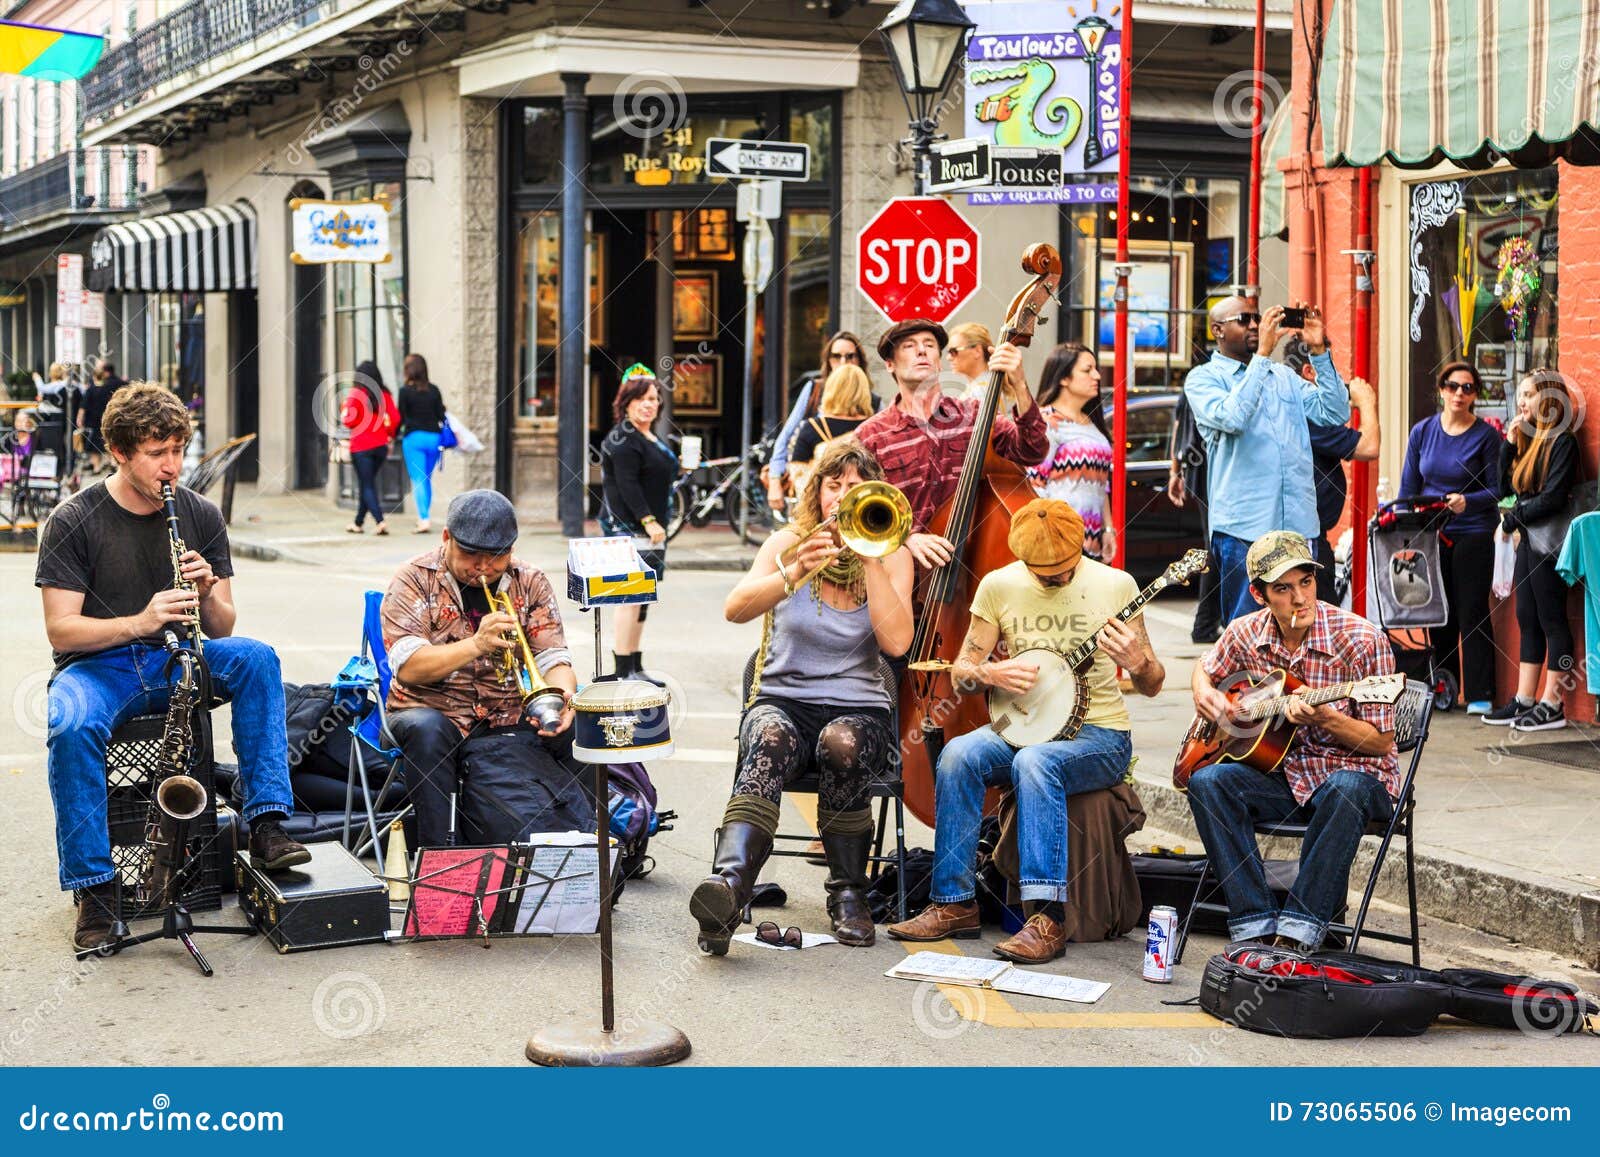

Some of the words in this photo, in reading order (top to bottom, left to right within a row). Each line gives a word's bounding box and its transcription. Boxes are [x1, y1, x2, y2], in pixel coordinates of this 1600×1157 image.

[978, 35, 1078, 58] Toulouse
[1099, 43, 1121, 150] Royale
[662, 127, 694, 147] 541
[623, 152, 662, 172] Rue
[667, 152, 706, 175] Roy
[739, 152, 766, 166] ONE
[770, 155, 796, 168] WAY
[941, 153, 978, 180] Royal
[995, 160, 1060, 183] louse
[1077, 187, 1095, 200] TO
[865, 238, 971, 285] STOP
[1013, 617, 1018, 635] I
[1022, 613, 1088, 634] LOVE
